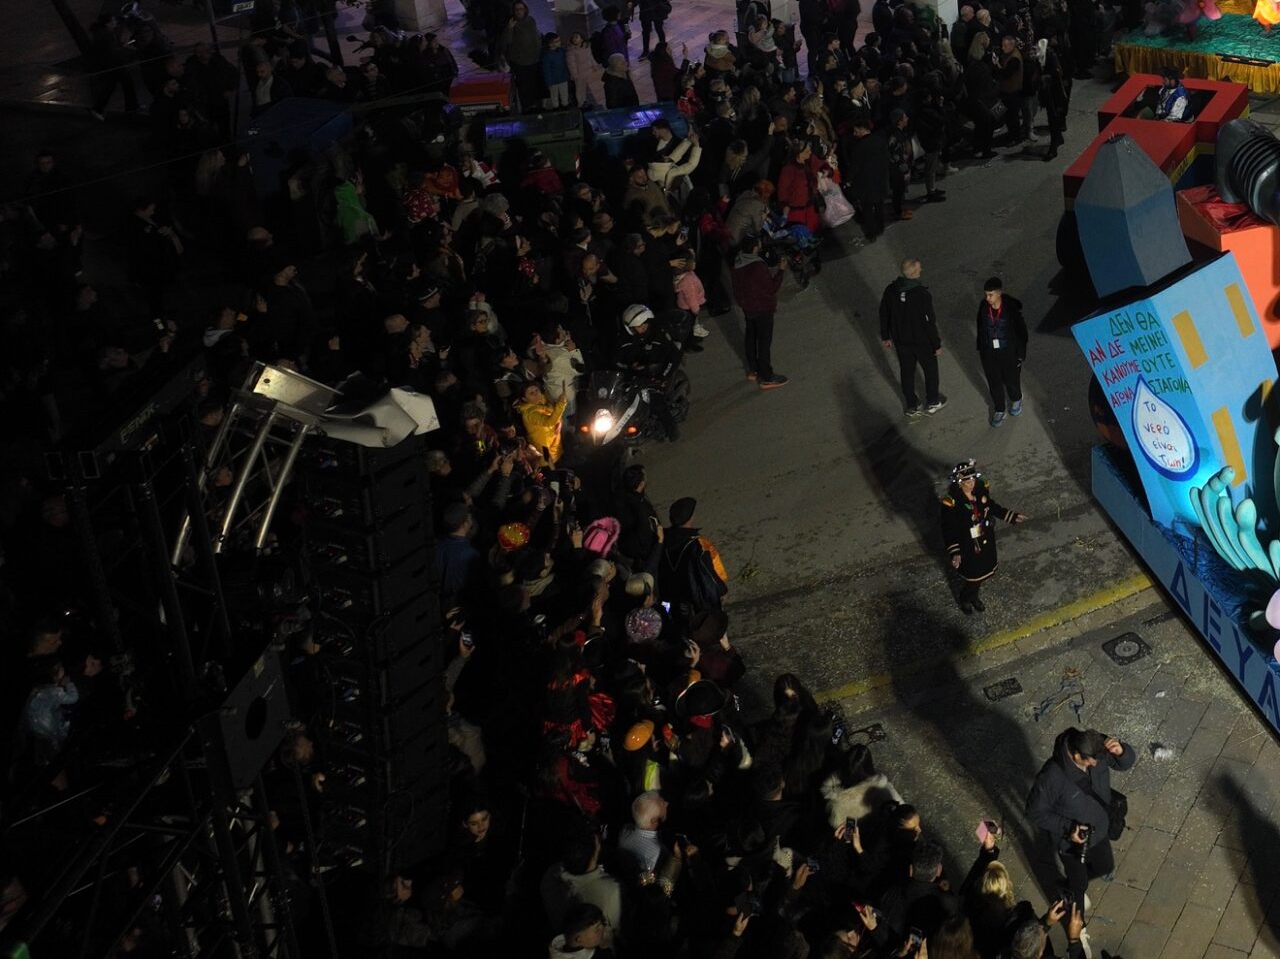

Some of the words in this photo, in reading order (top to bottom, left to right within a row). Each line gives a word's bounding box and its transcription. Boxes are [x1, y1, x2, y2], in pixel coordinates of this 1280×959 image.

[1108, 310, 1135, 337] ΔΕΝ
[1135, 311, 1160, 331] ΘΑ
[1088, 339, 1107, 367] ΑΝ
[1107, 338, 1126, 359] ΔΕ
[1129, 330, 1168, 356] ΜΕΙΝΕΙ
[1102, 359, 1141, 387] ΚΑΝΟΥΜΕ
[1141, 352, 1176, 374] ΟΥΤΕ
